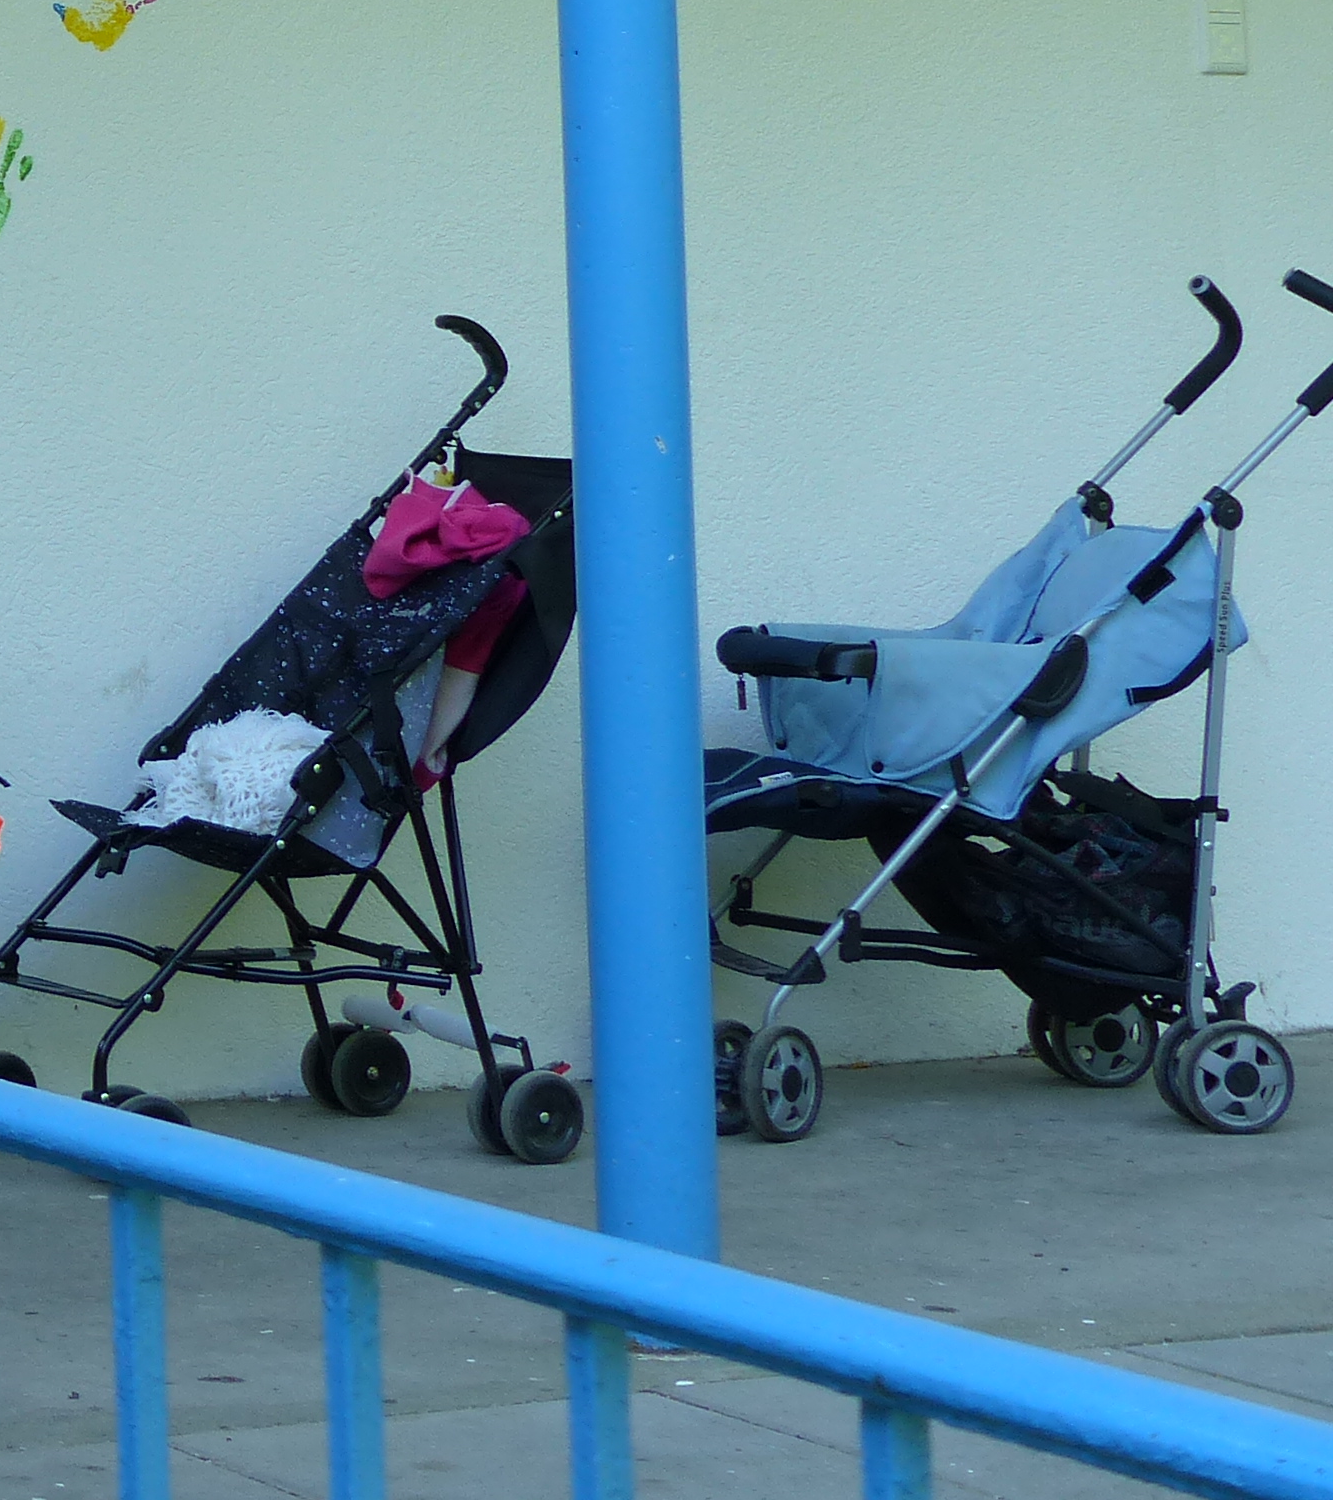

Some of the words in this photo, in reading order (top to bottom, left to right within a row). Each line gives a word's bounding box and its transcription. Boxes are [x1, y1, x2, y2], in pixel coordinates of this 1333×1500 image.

[1220, 582, 1232, 601] Plus
[1219, 604, 1229, 621] Sun
[1217, 623, 1228, 653] Speed
